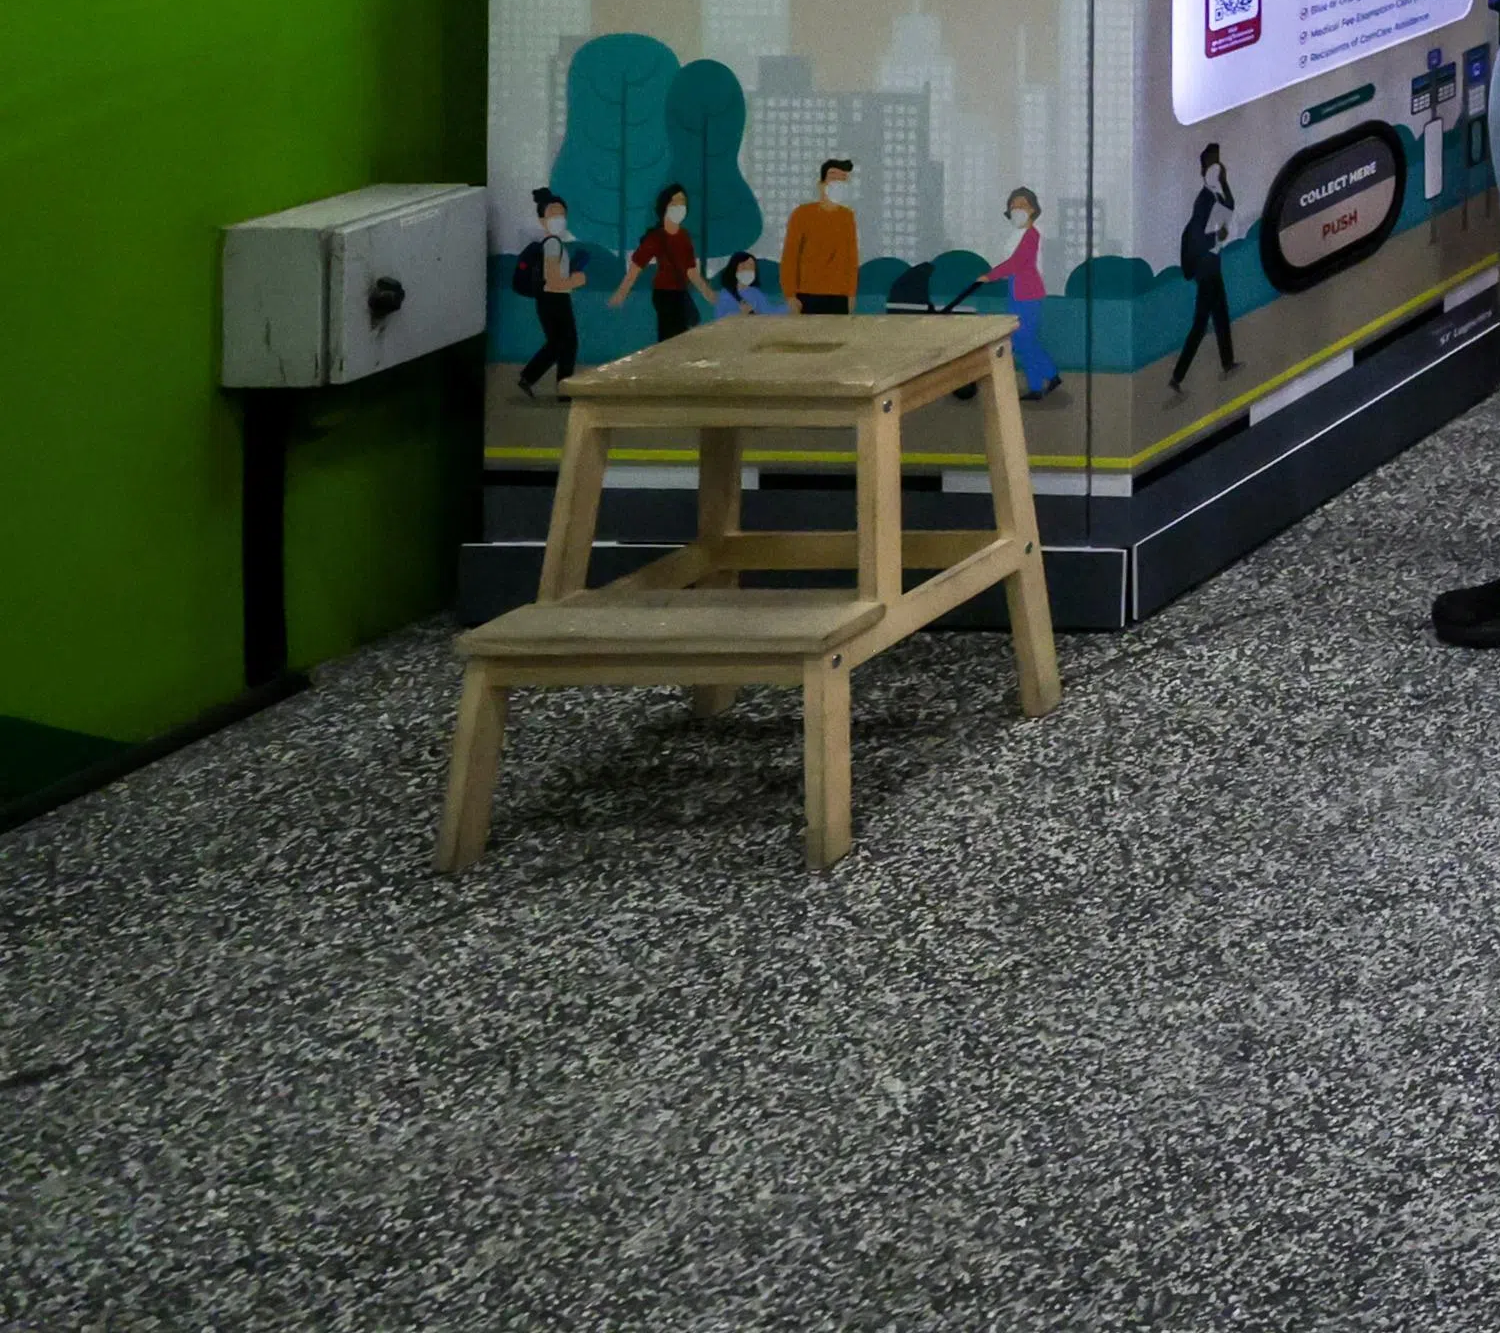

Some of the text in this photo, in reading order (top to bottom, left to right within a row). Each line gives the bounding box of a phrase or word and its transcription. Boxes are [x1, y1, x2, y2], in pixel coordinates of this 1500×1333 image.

[1299, 160, 1378, 208] COLLECT HERE
[1321, 207, 1359, 239] PUSH
